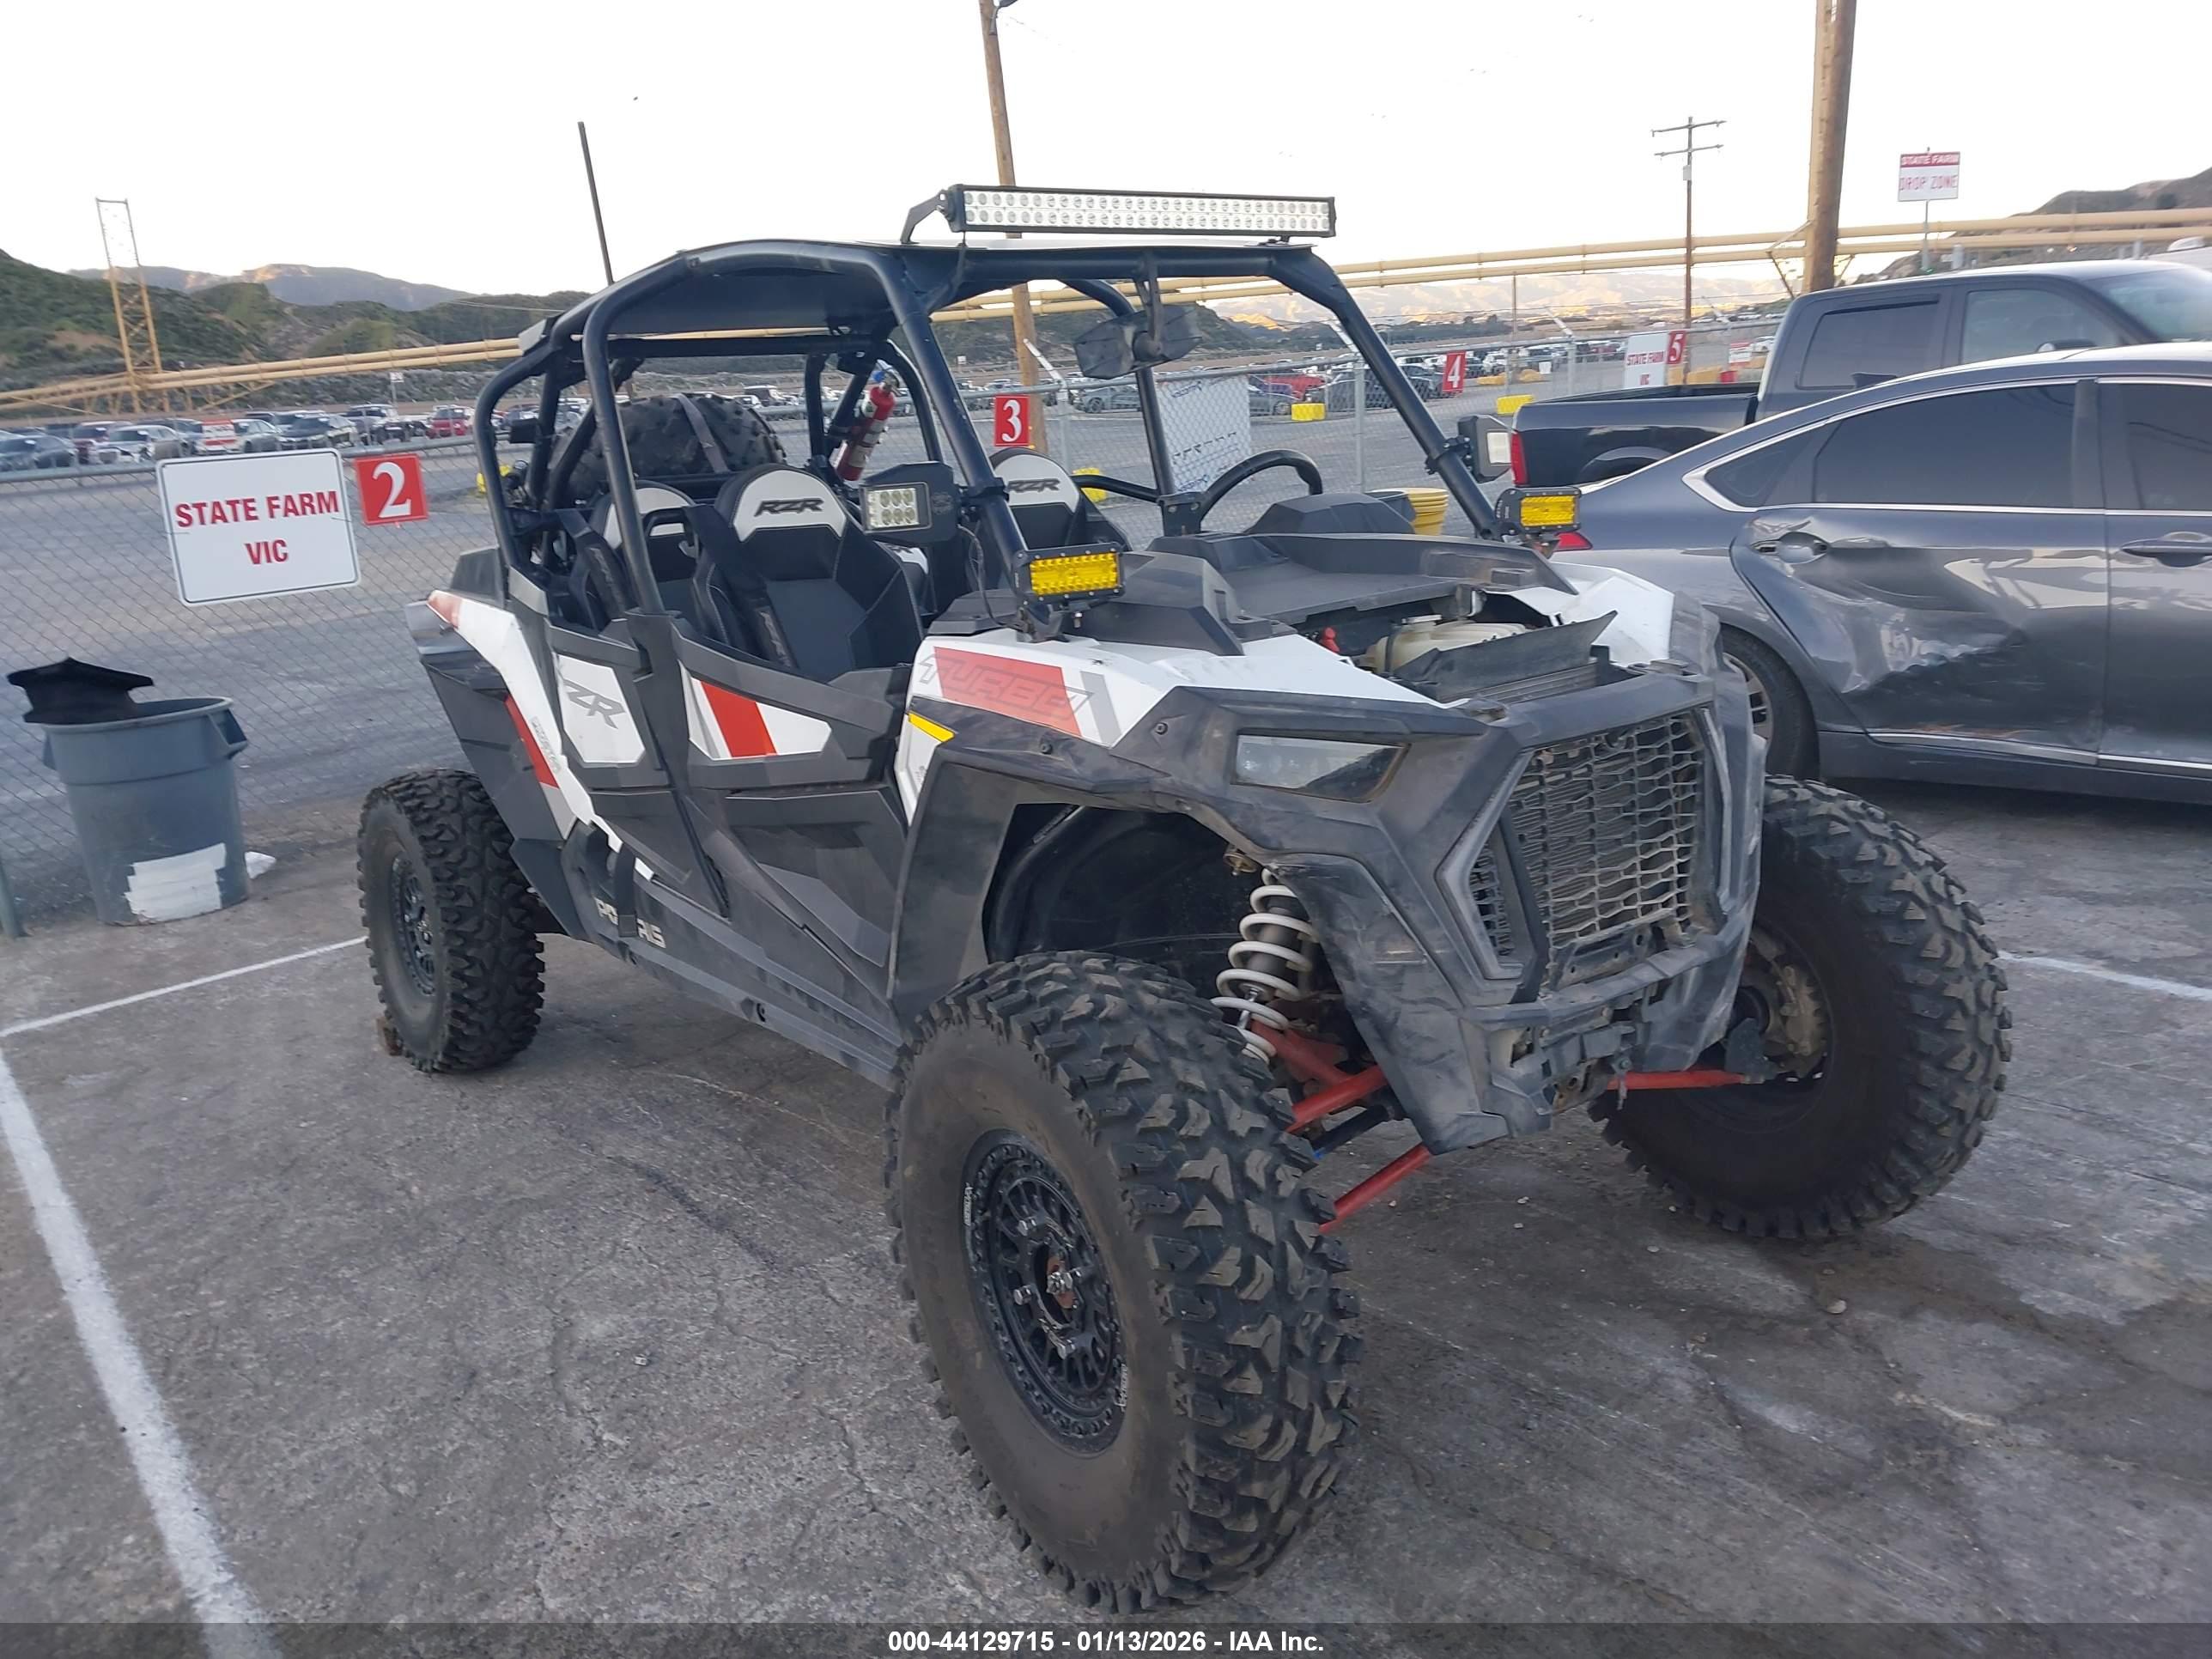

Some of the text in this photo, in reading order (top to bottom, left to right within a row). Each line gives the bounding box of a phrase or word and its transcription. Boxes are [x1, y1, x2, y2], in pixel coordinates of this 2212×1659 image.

[1626, 353, 1646, 366] STATE
[1669, 333, 1684, 362] 5
[1447, 355, 1461, 388] 4
[1001, 399, 1022, 442] 3
[373, 462, 412, 518] 2
[174, 491, 339, 527] STATE FARM
[754, 498, 823, 517] RZR
[244, 539, 289, 565] VIC
[920, 653, 1095, 720] TURBO
